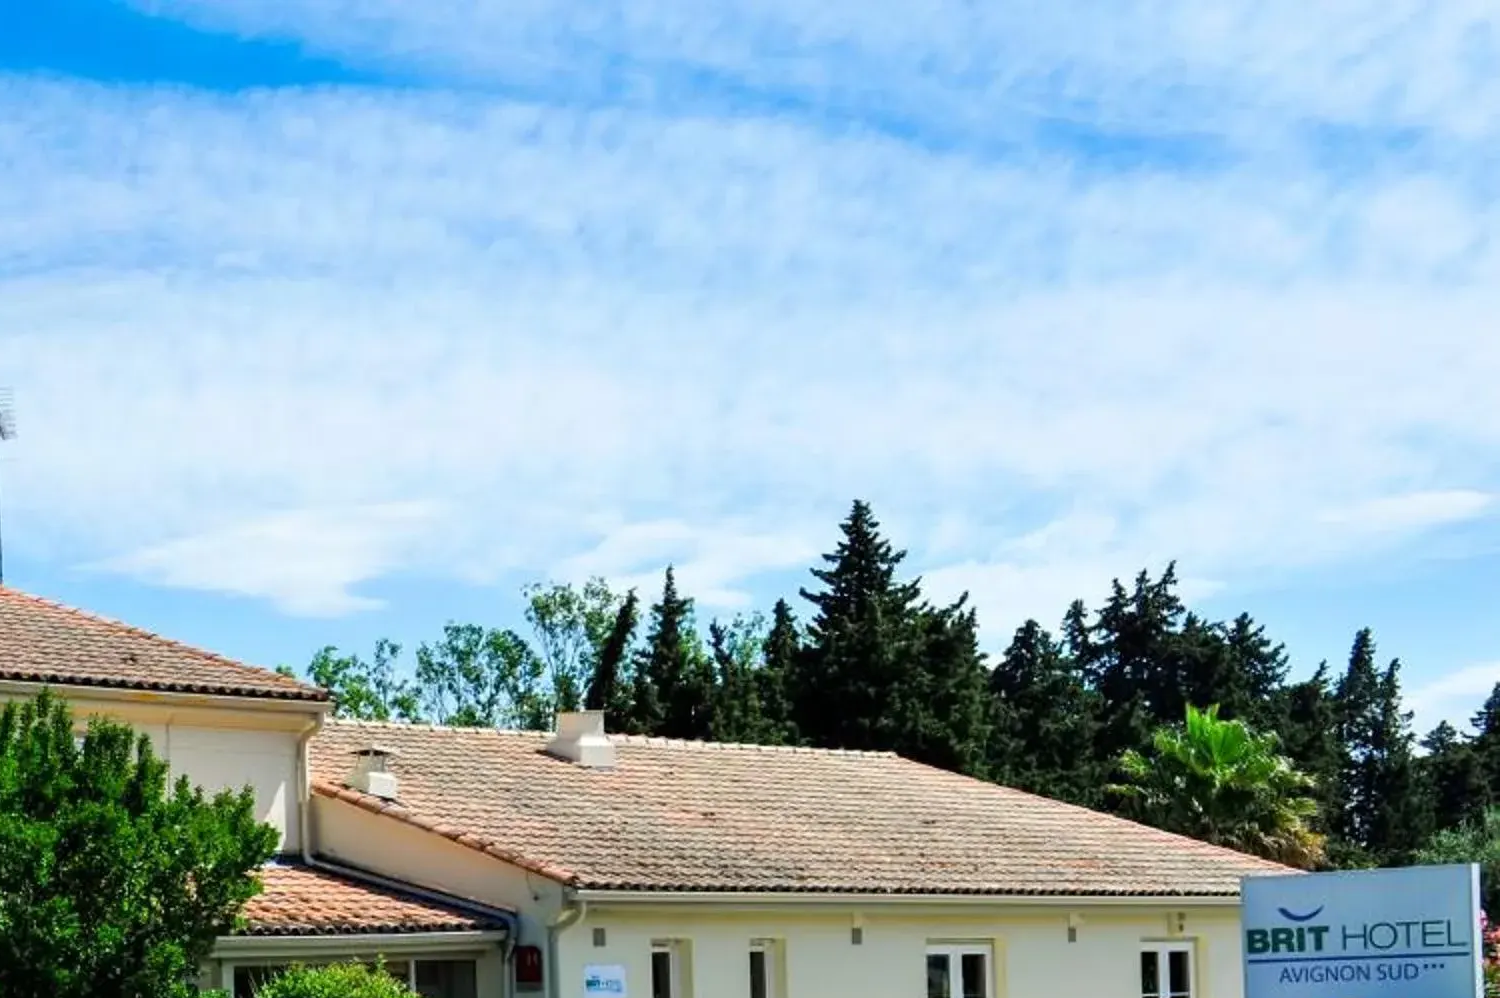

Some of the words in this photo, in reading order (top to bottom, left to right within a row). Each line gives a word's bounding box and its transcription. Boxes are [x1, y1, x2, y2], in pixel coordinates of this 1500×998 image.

[1246, 926, 1329, 953] BRIT
[1342, 919, 1468, 950] HOTEL
[1279, 964, 1370, 983] AVIGNON
[1376, 963, 1419, 981] SUD
